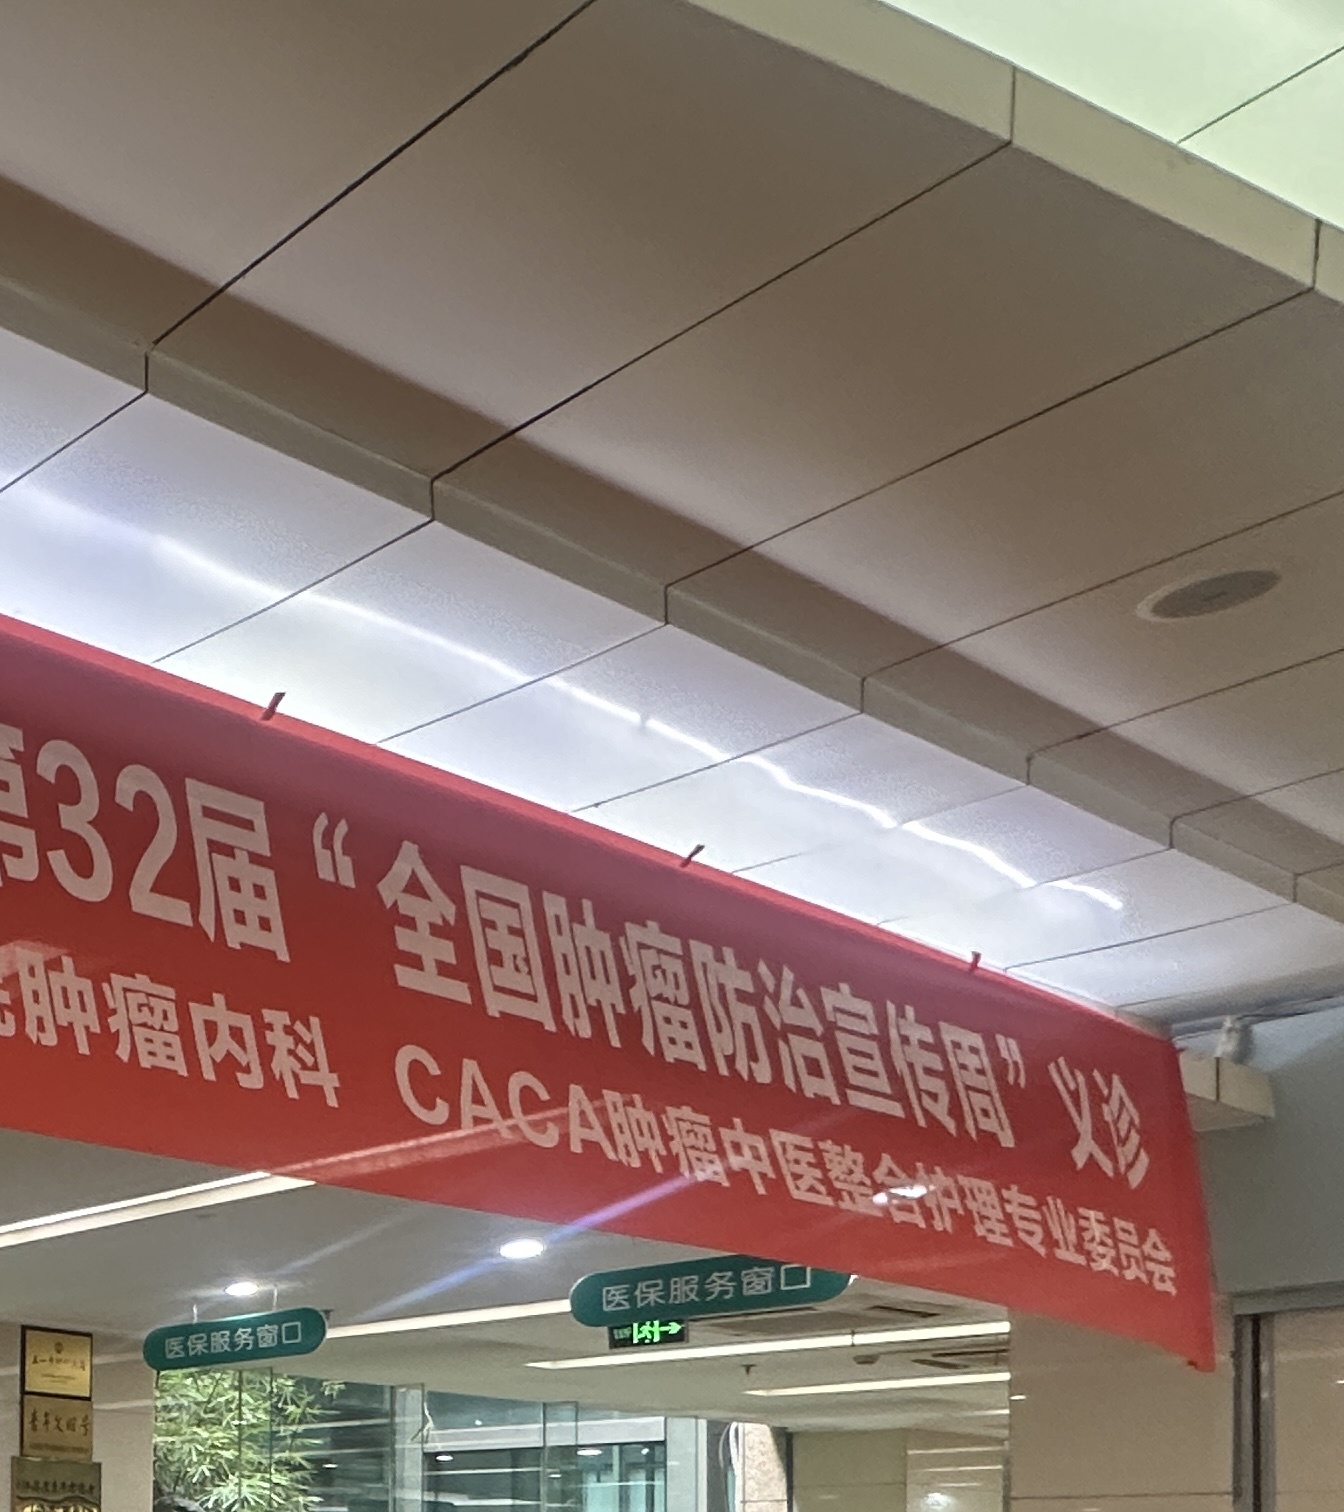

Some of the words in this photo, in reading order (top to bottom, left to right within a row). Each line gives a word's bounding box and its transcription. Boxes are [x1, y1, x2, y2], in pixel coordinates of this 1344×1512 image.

[601, 1264, 812, 1312] 医保服务窗口
[164, 1321, 302, 1360] 医保服务窗口
